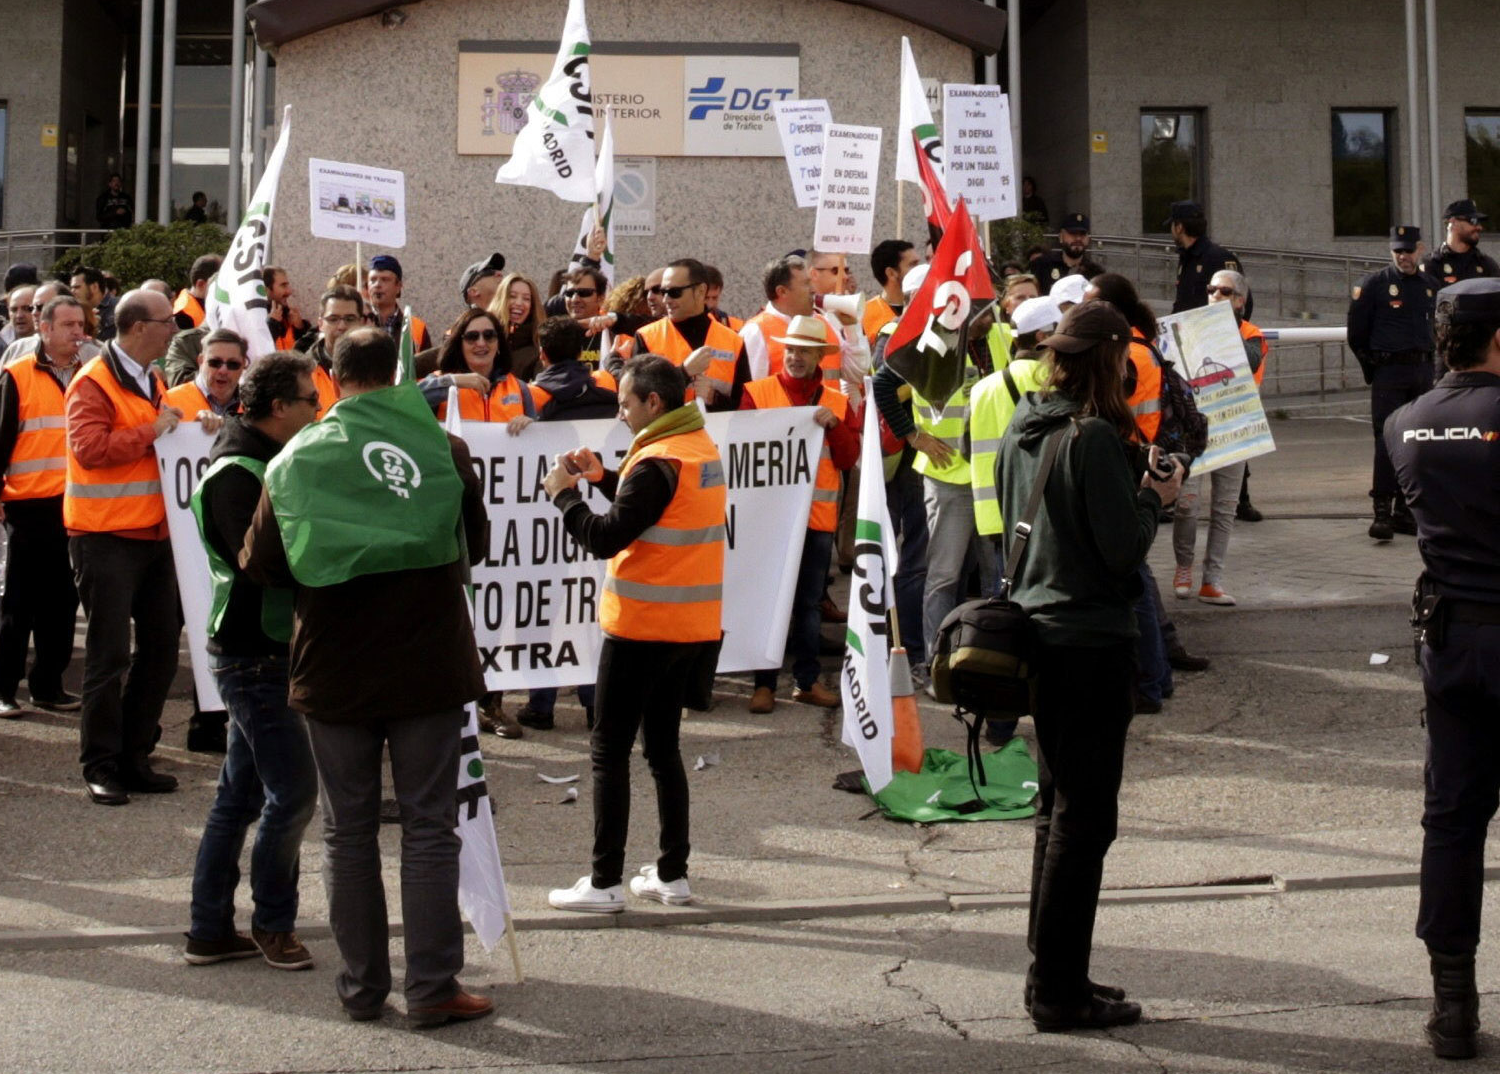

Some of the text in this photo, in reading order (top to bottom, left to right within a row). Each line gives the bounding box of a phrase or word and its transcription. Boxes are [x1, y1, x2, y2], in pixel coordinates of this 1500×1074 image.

[591, 94, 645, 106] ISTERIO
[729, 88, 794, 111] DGT
[723, 113, 762, 122] Dirección
[723, 122, 734, 131] de
[1403, 427, 1482, 443] POLICIA
[728, 427, 812, 489] MERÍA
[515, 579, 551, 630] DE
[561, 576, 597, 625] TR
[478, 640, 580, 673] XTRA
